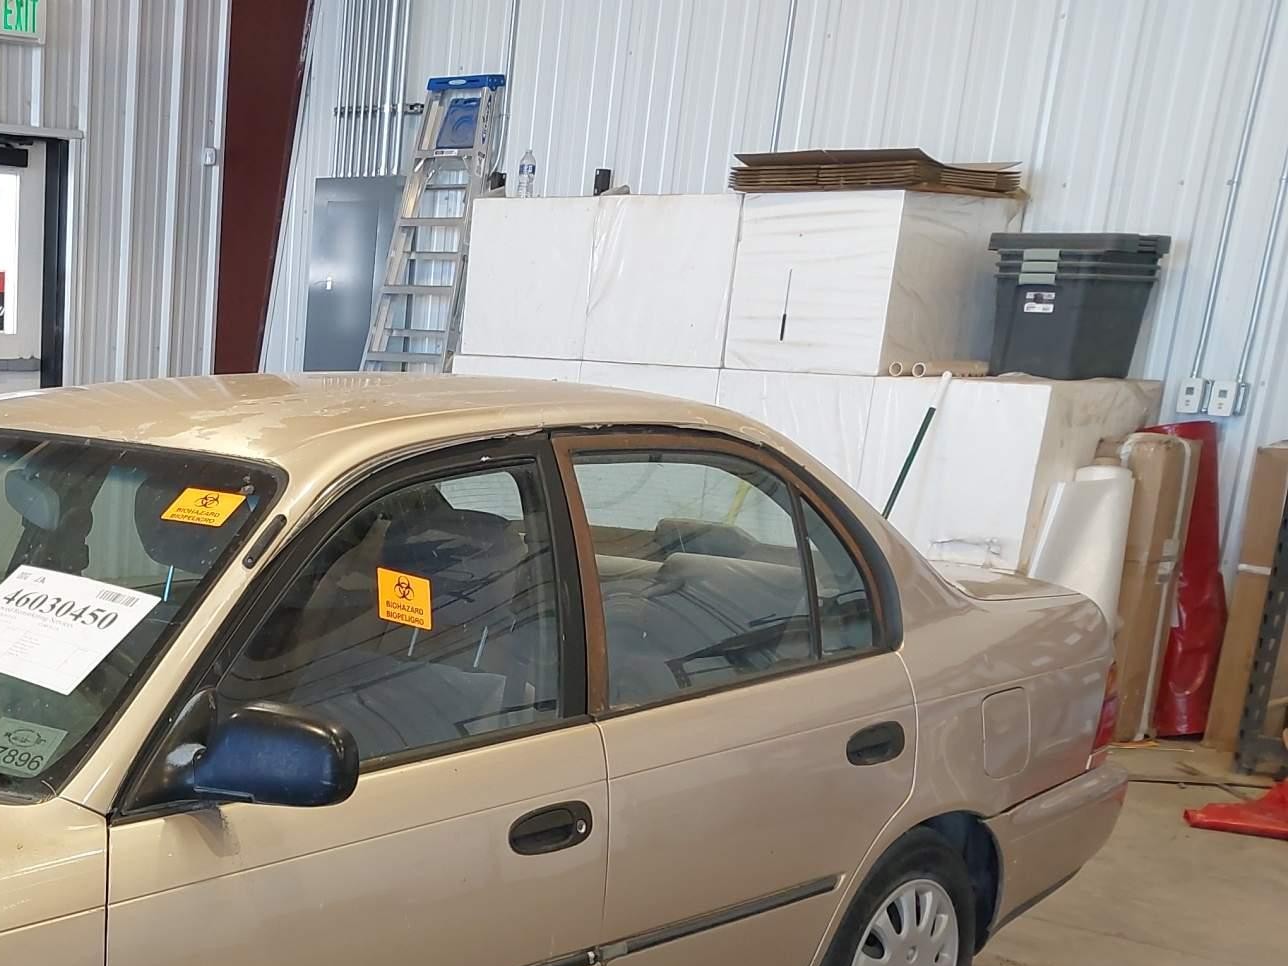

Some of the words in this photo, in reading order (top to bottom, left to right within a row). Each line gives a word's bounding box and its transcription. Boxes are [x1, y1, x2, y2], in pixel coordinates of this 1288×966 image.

[4, 0, 38, 33] EXIT
[170, 513, 215, 523] BIOPELIGRO
[176, 507, 221, 517] BIOHAZARD
[3, 588, 119, 630] 46030450
[385, 600, 424, 616] BIOHAZARD
[386, 610, 425, 626] BIOPELIGRO
